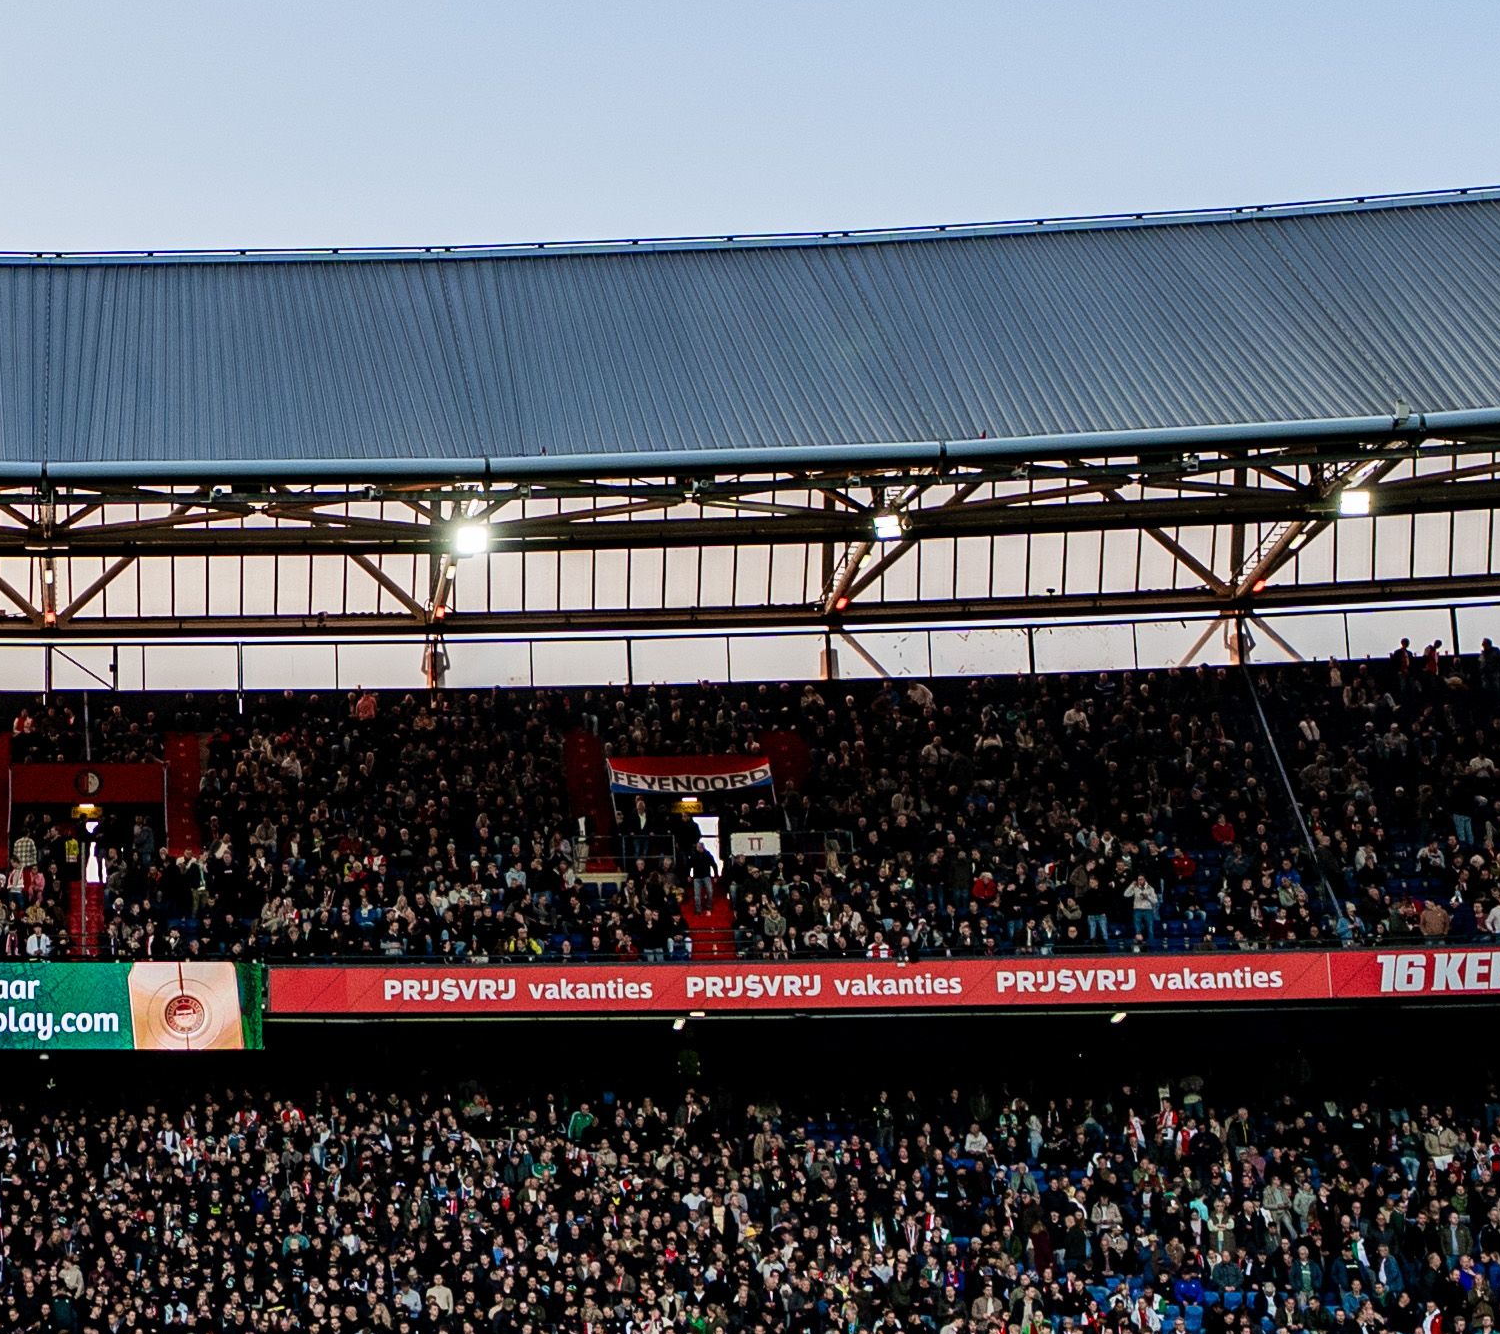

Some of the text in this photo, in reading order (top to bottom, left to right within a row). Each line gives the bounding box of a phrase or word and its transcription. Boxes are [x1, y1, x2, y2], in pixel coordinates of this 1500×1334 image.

[613, 769, 769, 792] FEYENOORD
[748, 836, 764, 851] TT
[833, 972, 963, 996] vakanties
[1149, 966, 1284, 990] vakanties
[1377, 953, 1427, 993] 16
[527, 977, 653, 1000] vakanties
